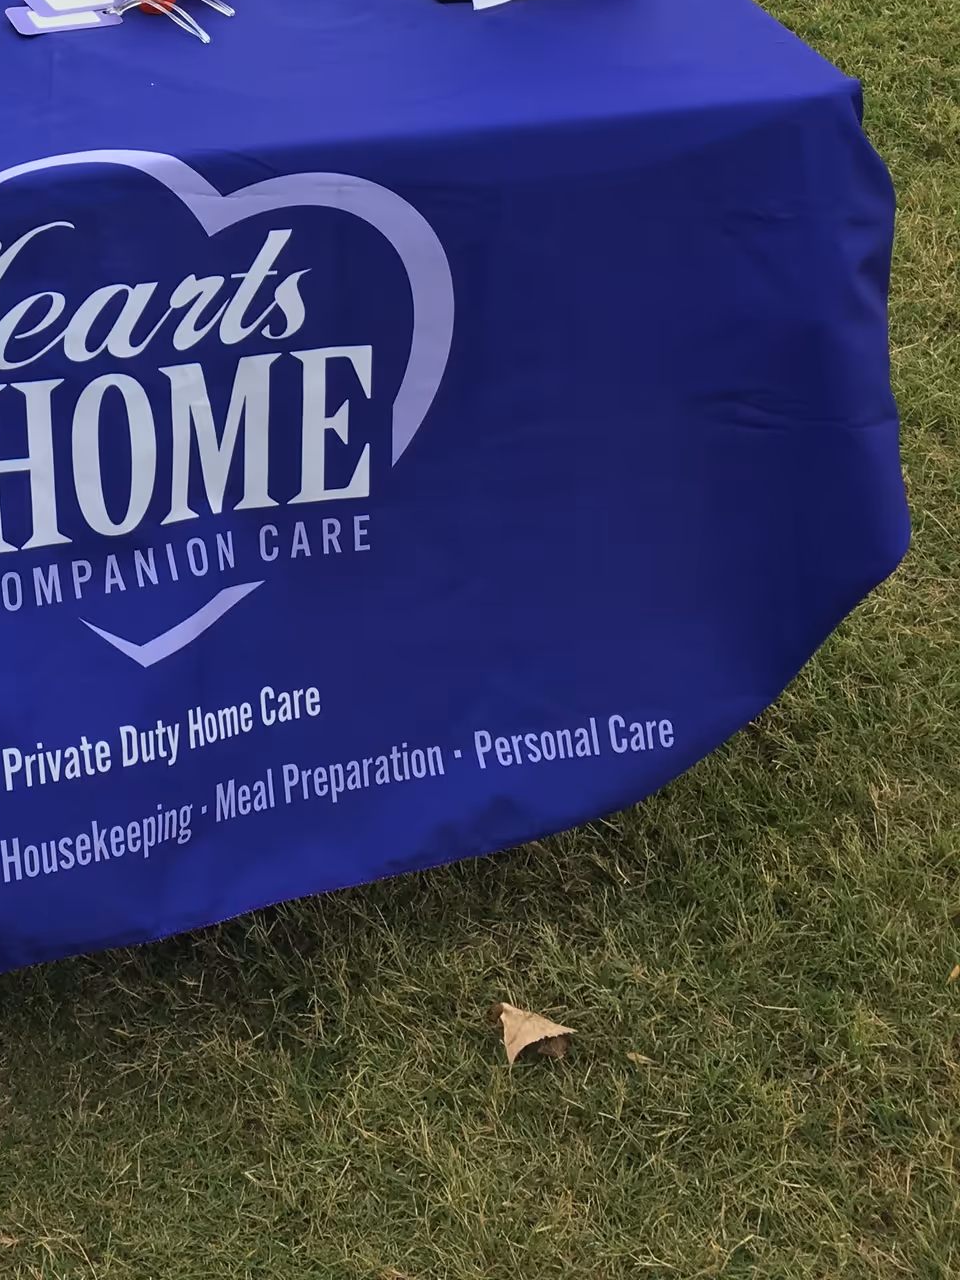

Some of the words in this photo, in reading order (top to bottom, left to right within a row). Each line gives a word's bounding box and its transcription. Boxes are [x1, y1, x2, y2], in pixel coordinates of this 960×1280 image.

[258, 514, 372, 562] CARE
[1, 734, 113, 792] Private
[118, 720, 180, 768] Duty
[187, 700, 254, 750] Home
[259, 685, 322, 726] Care
[0, 802, 194, 883] Housekeeping
[214, 768, 276, 823] Meal
[282, 741, 446, 804] Preparation
[473, 717, 601, 769] Personal
[607, 713, 676, 755] Care
